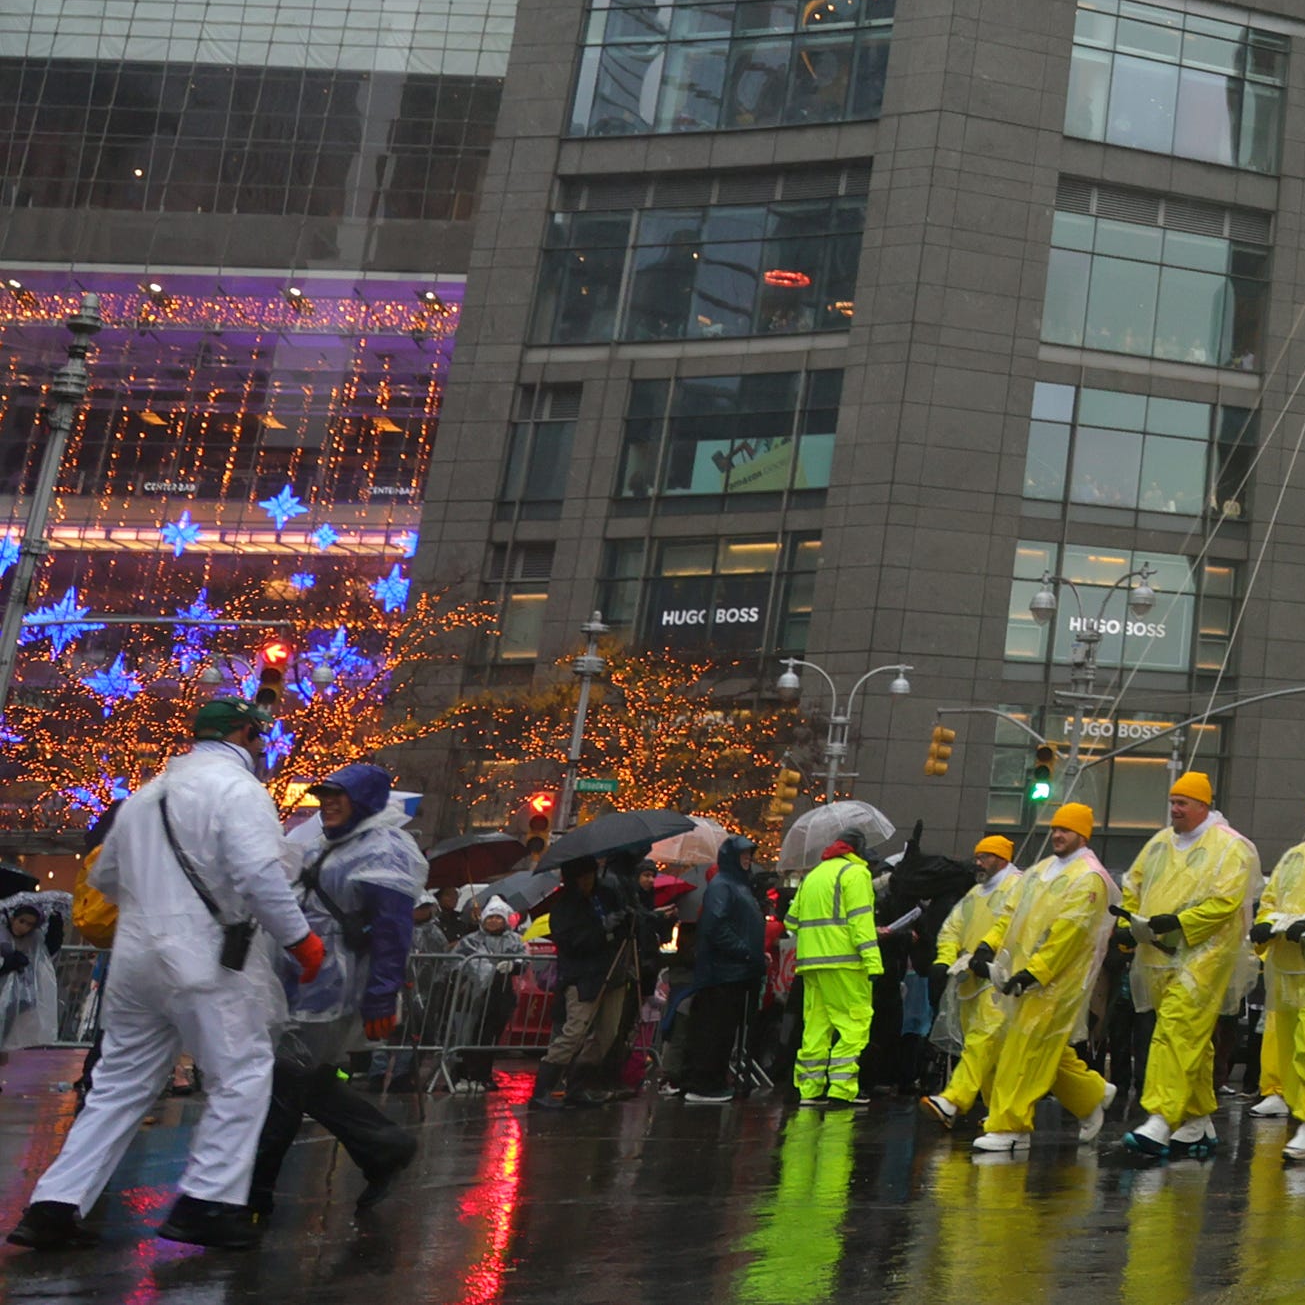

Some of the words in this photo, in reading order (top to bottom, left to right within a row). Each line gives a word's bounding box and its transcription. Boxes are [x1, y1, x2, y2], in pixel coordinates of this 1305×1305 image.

[715, 606, 759, 624] BOSS
[1125, 621, 1166, 638] BOSS
[1117, 723, 1161, 740] BOSS
